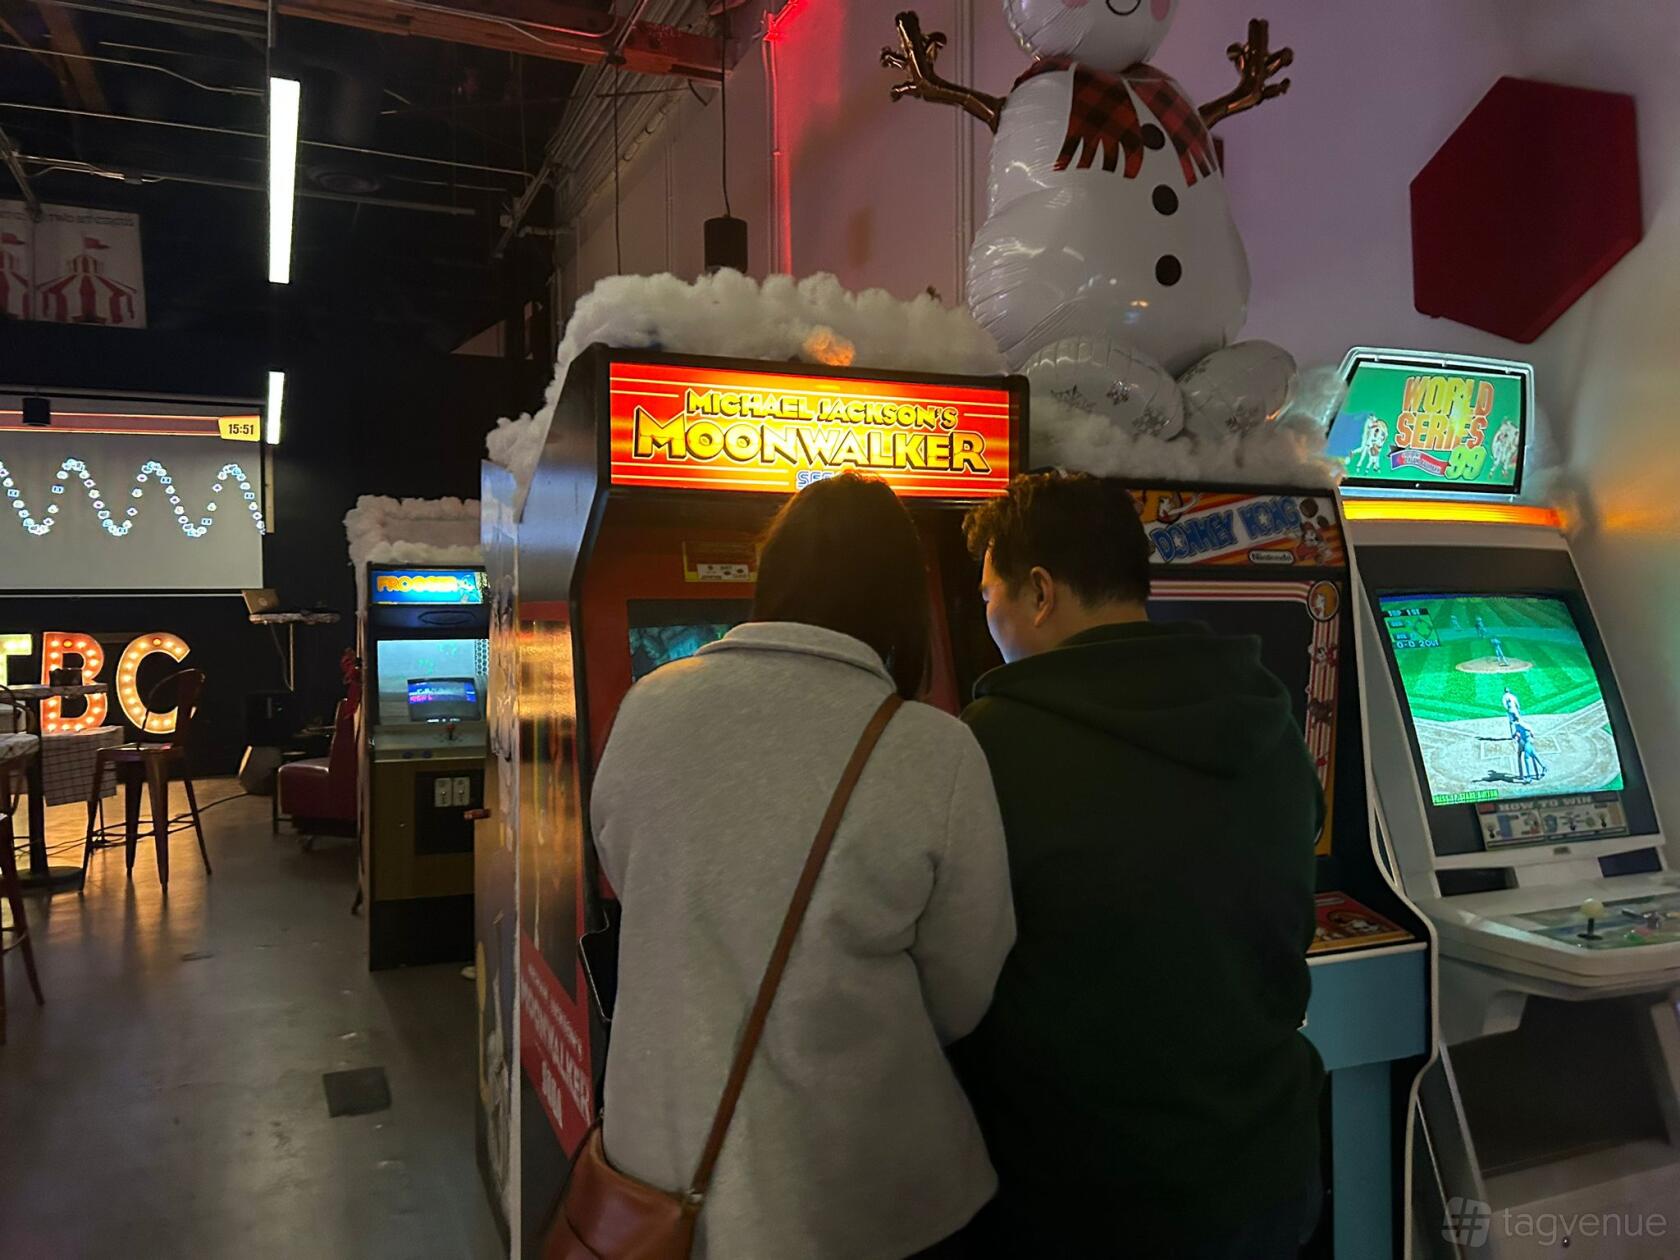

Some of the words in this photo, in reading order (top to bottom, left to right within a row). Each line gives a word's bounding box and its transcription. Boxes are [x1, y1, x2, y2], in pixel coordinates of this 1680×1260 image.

[685, 387, 818, 421] MICHAEL
[817, 397, 960, 431] JACKSON'S
[1402, 375, 1495, 417] WORLD
[228, 423, 254, 435] 15:51
[632, 404, 994, 474] MOONWALKER
[1394, 411, 1488, 451] SERIES
[797, 470, 834, 488] SE
[1150, 508, 1239, 563] DONKEY
[1236, 495, 1302, 541] KONG
